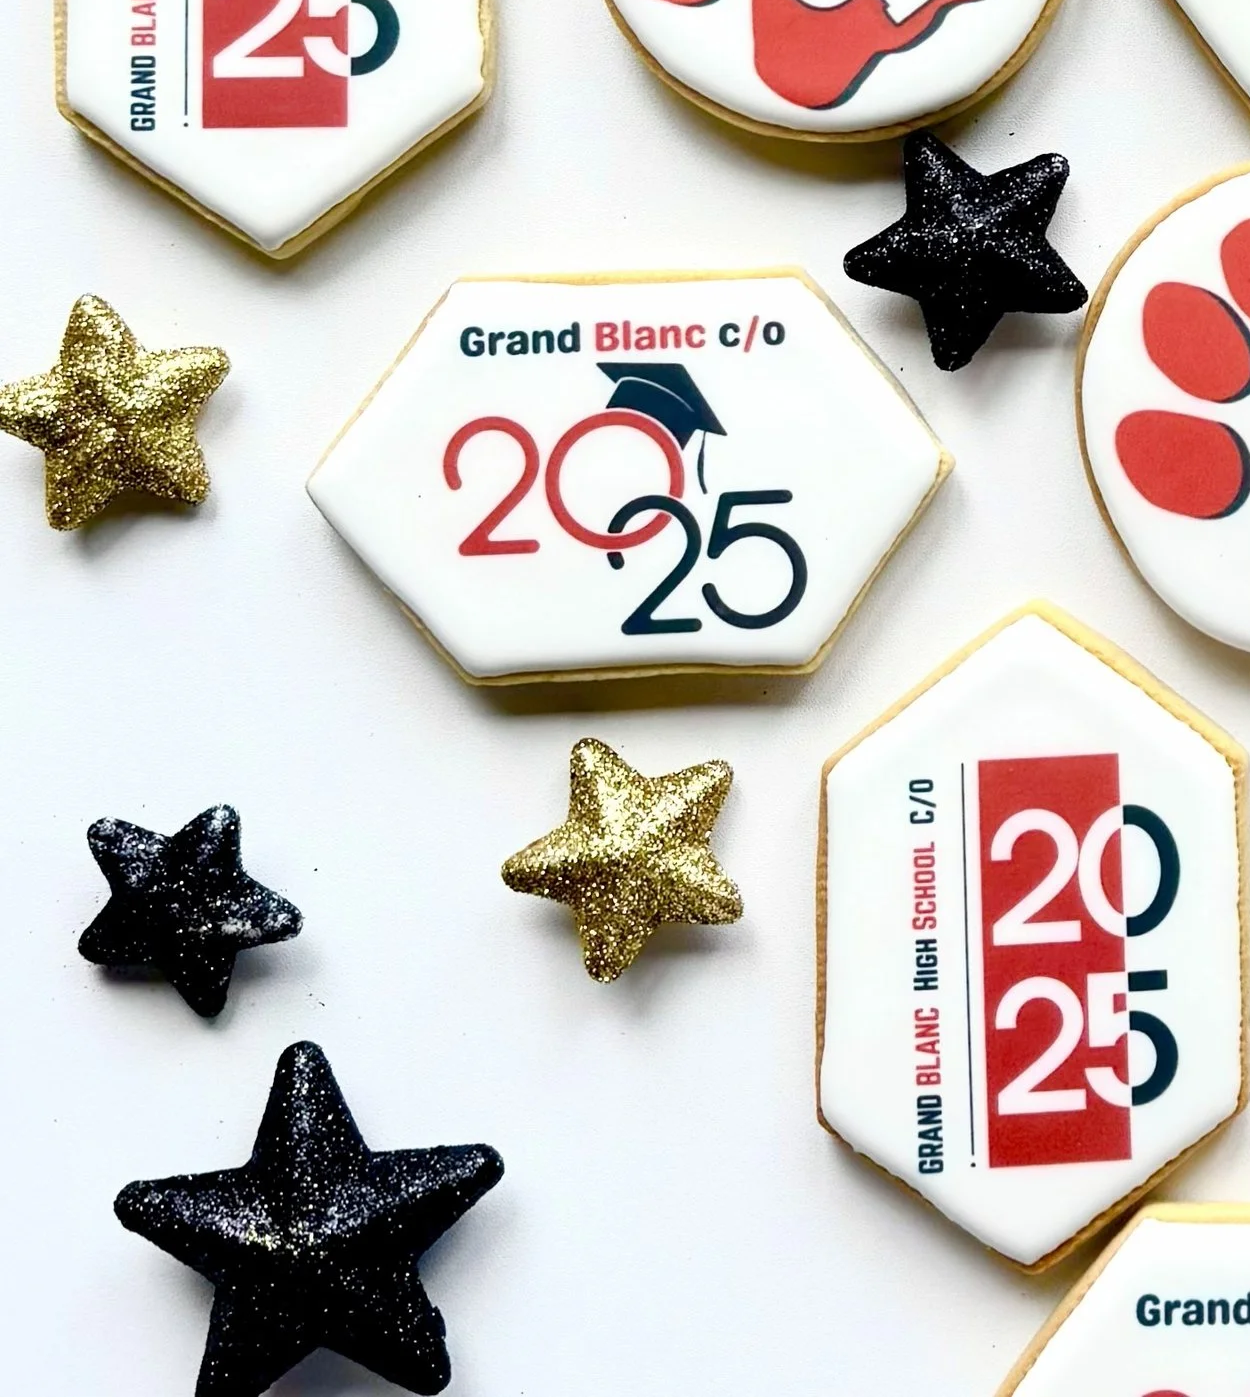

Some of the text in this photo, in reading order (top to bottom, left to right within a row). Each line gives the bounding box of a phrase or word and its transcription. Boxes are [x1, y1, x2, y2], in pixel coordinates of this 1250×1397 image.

[129, 55, 157, 132] GRAND
[459, 315, 786, 358] Grand Blanc c/o
[908, 778, 945, 1176] GRAND BLANC HIGH SCHOOL C/O
